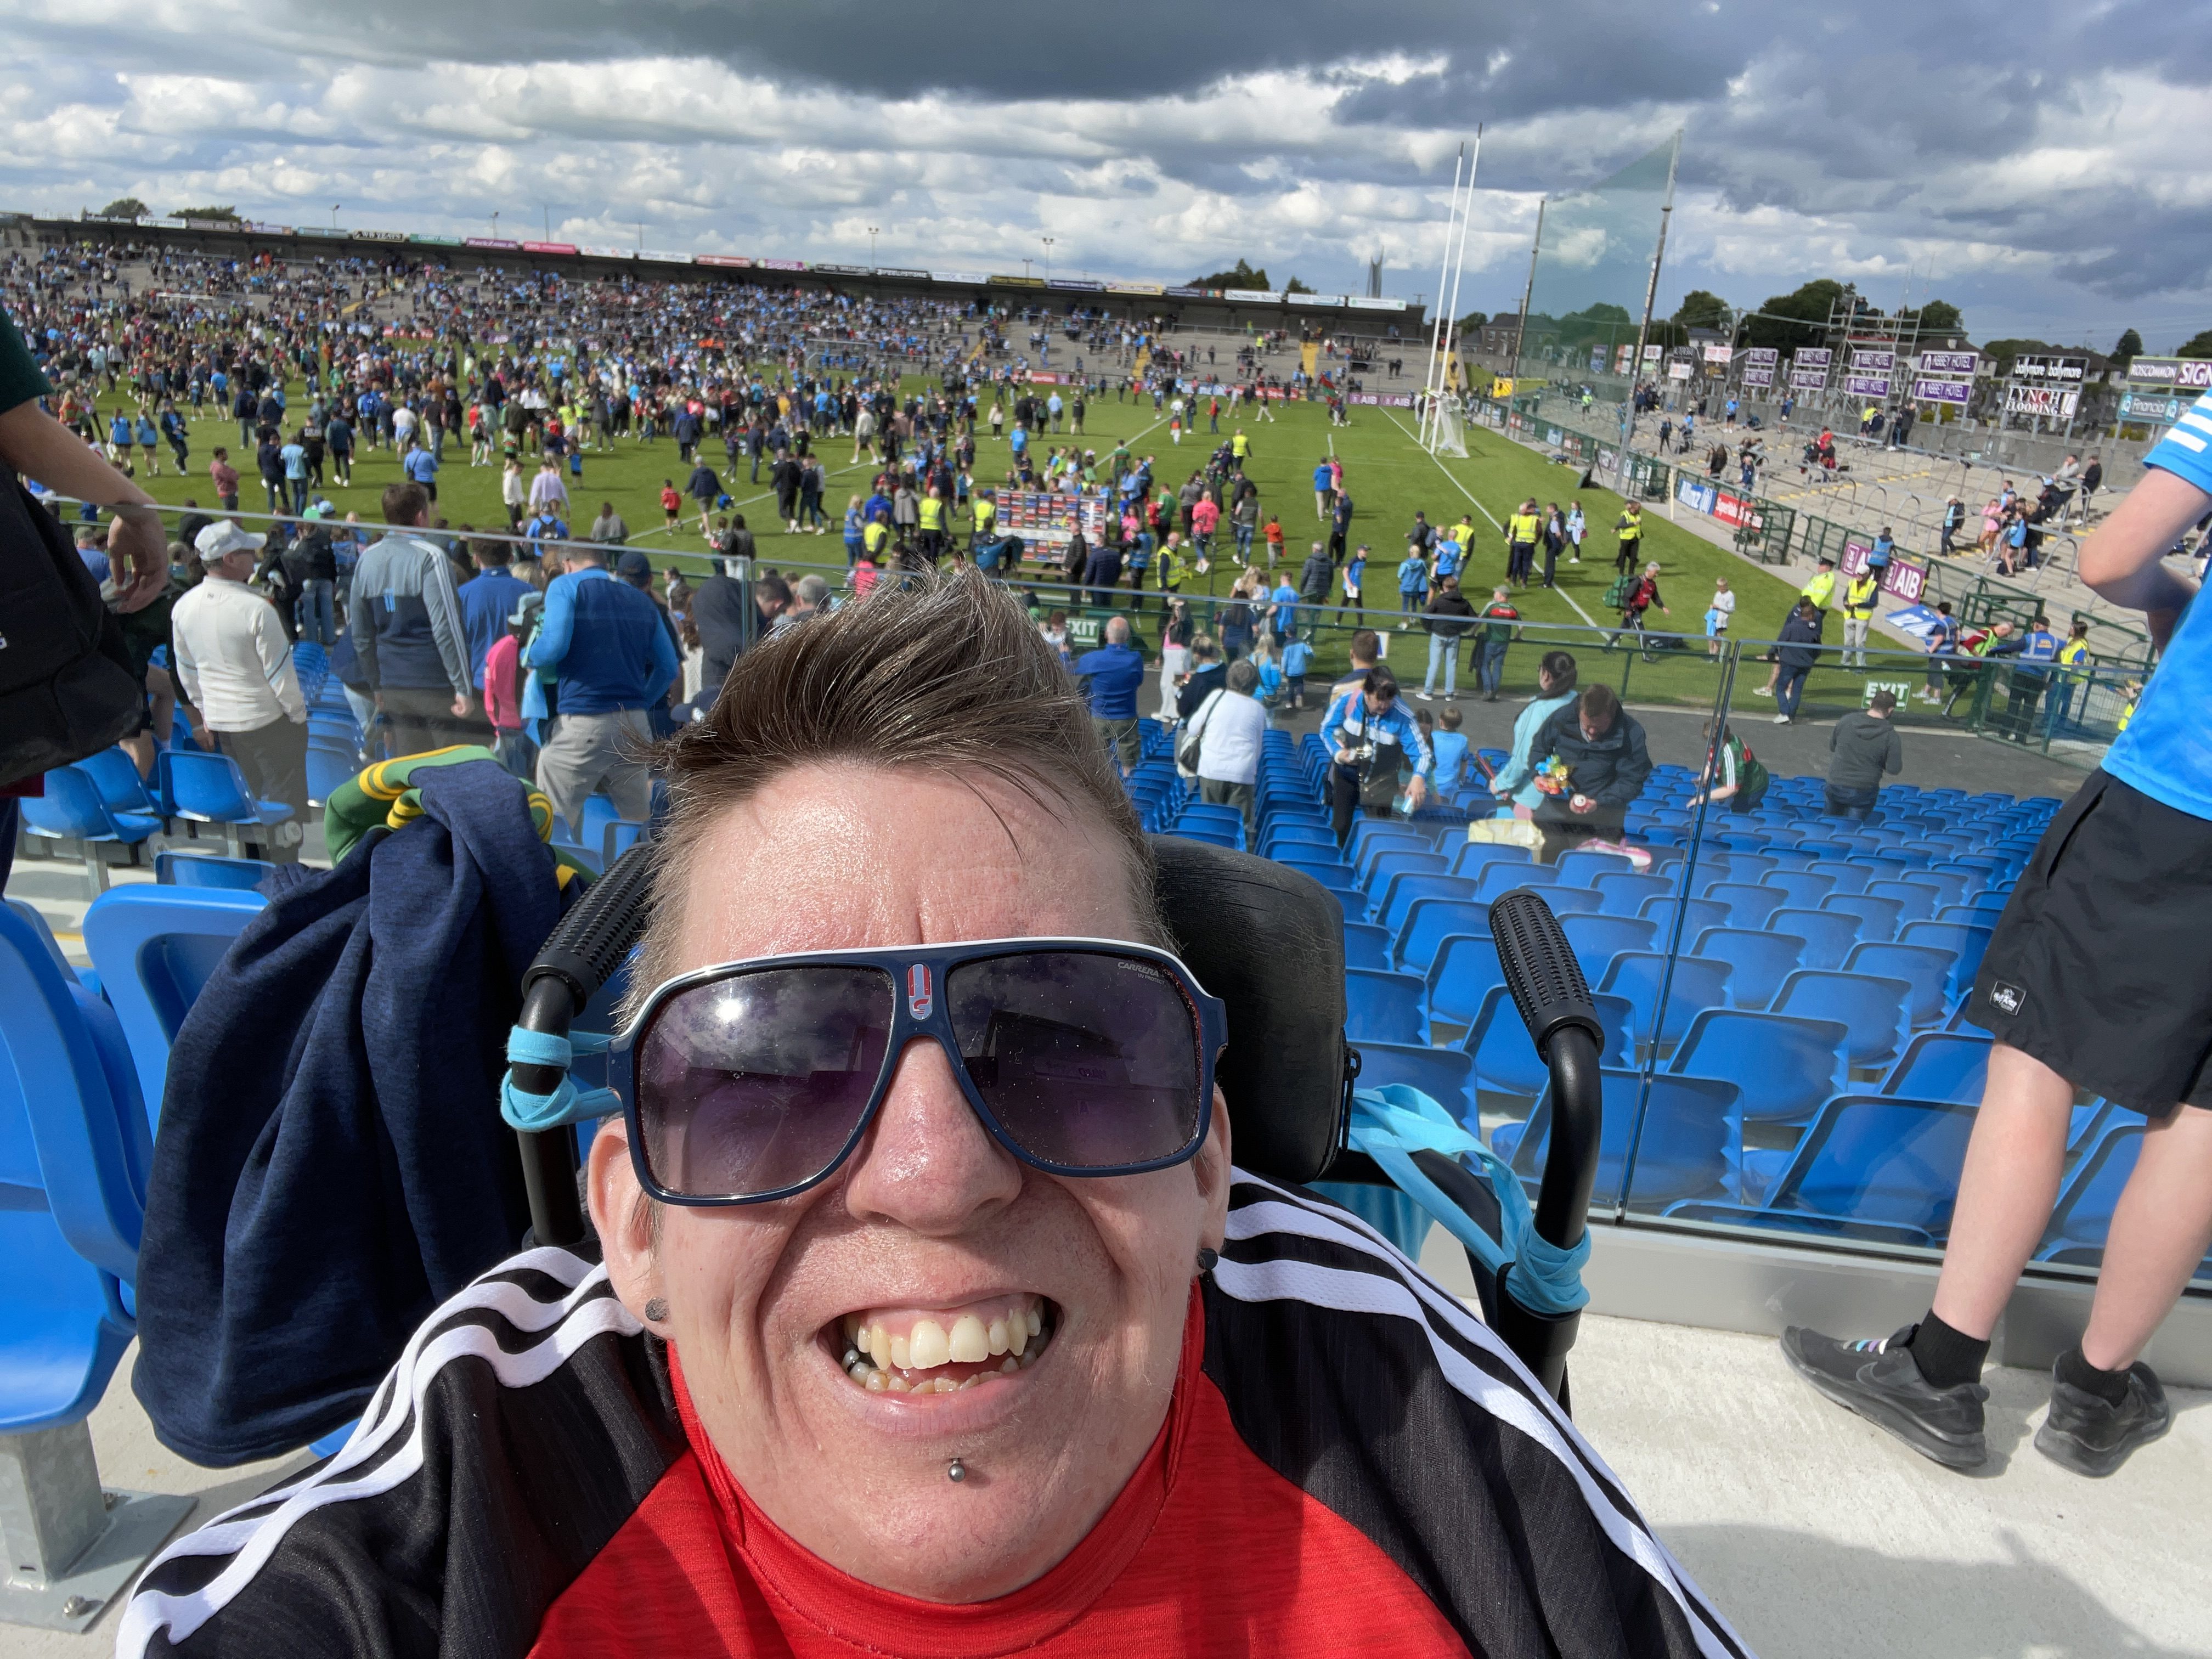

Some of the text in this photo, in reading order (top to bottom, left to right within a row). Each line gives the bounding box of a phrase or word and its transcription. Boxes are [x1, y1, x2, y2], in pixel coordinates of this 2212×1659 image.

[1932, 355, 1971, 369] ABBEY HOTEL
[2015, 357, 2082, 381] ballymore ballymore
[2131, 364, 2177, 378] ROSCOMMON
[1927, 382, 1963, 398] ABBEY HOTEL
[2008, 387, 2061, 404] LYNCH
[2006, 399, 2058, 415] FLOORING
[2132, 397, 2166, 413] Financial
[1893, 567, 1920, 599] AIB
[1118, 962, 1159, 977] CARRERA
[1145, 975, 1165, 985] PROTECT
